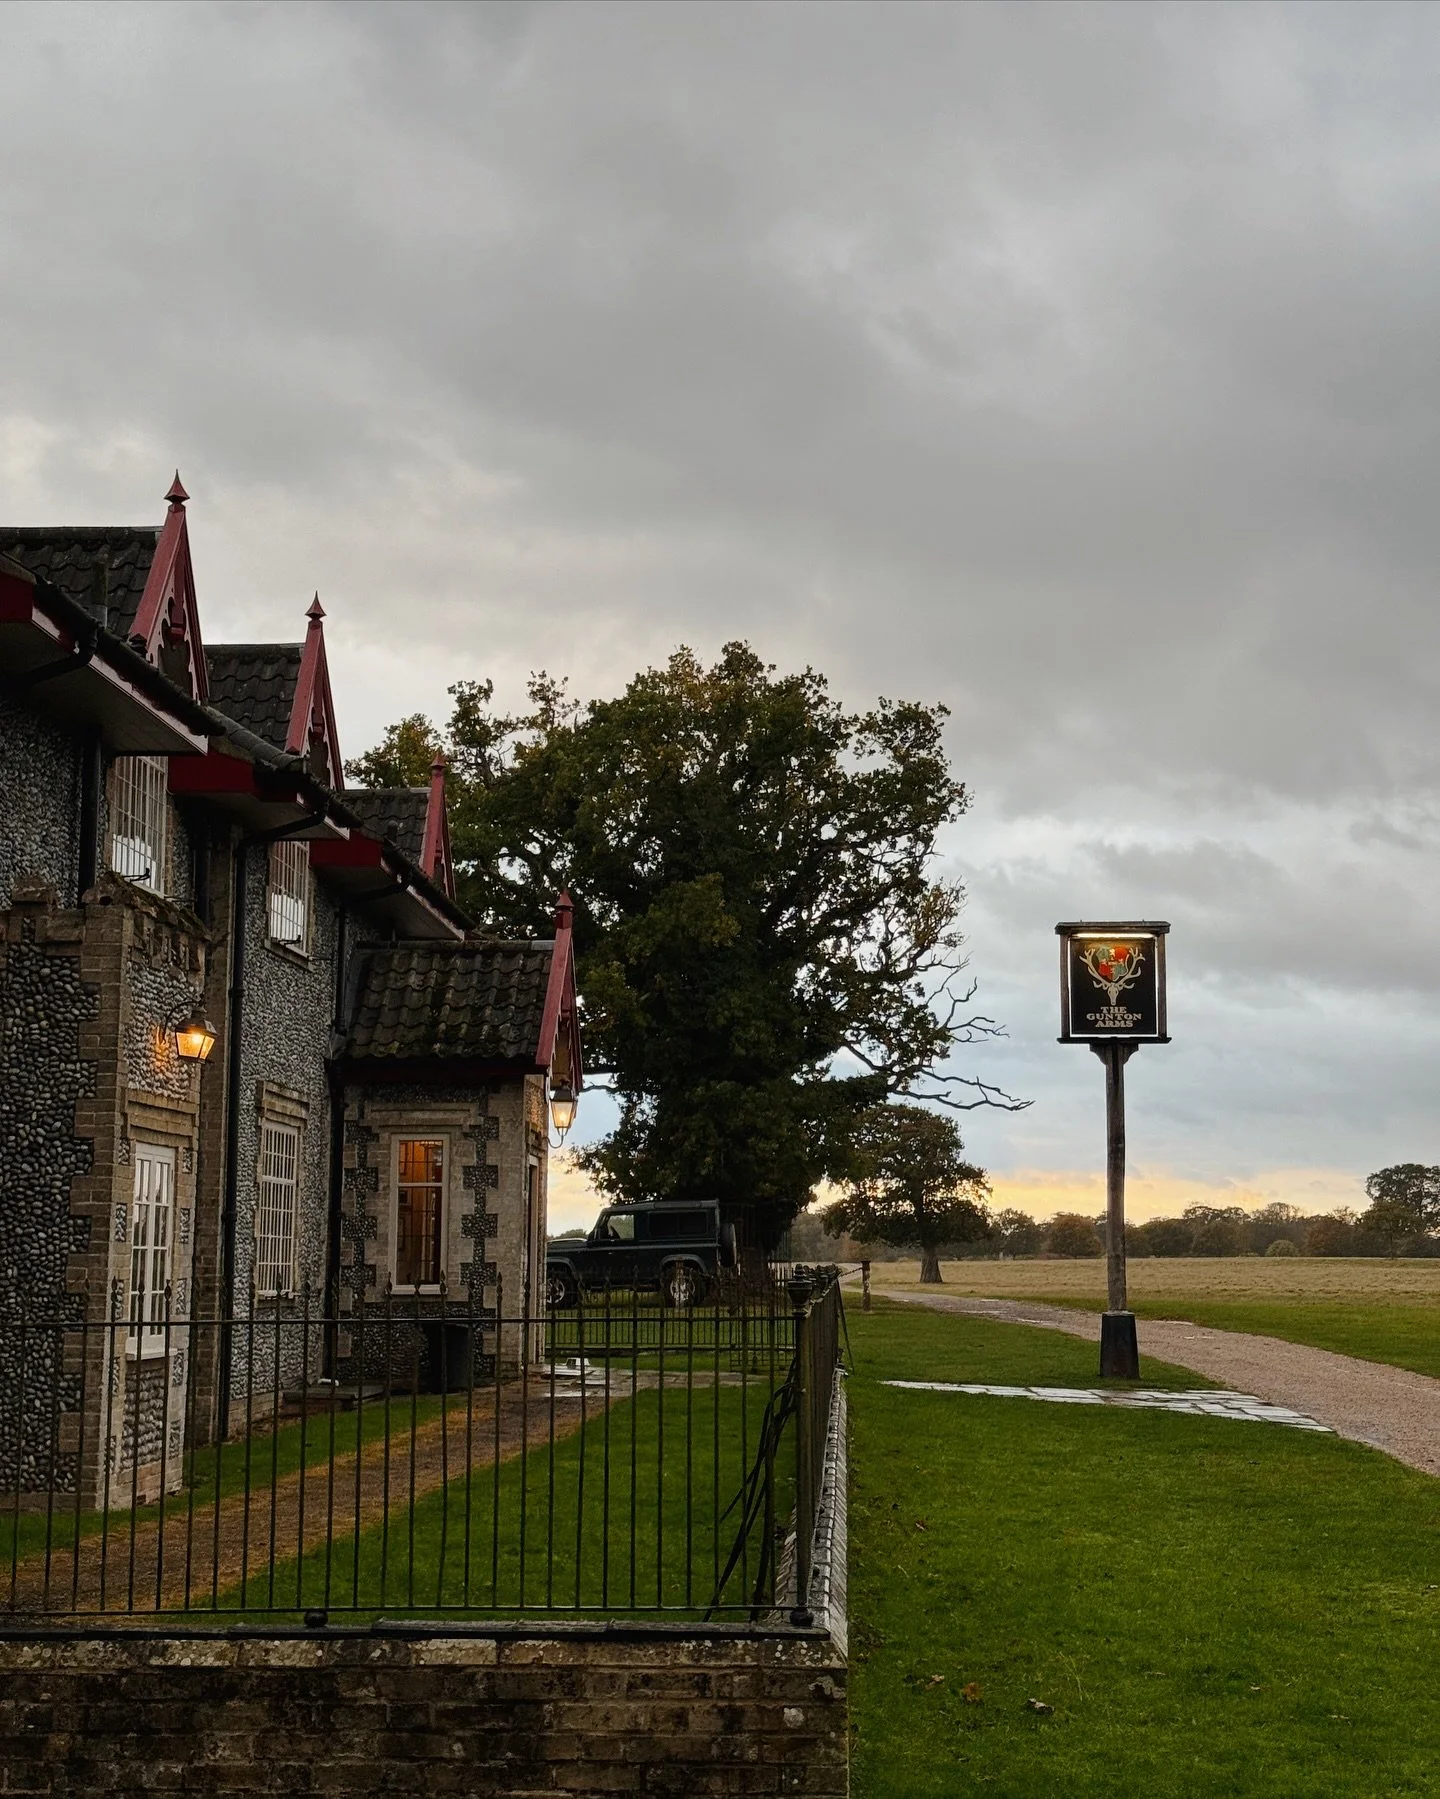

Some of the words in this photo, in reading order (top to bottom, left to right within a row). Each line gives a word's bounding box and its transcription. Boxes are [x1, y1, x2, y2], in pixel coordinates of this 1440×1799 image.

[1101, 1006, 1127, 1014] THE
[1086, 1013, 1142, 1021] GUNTON
[1095, 1020, 1134, 1028] ARMS
